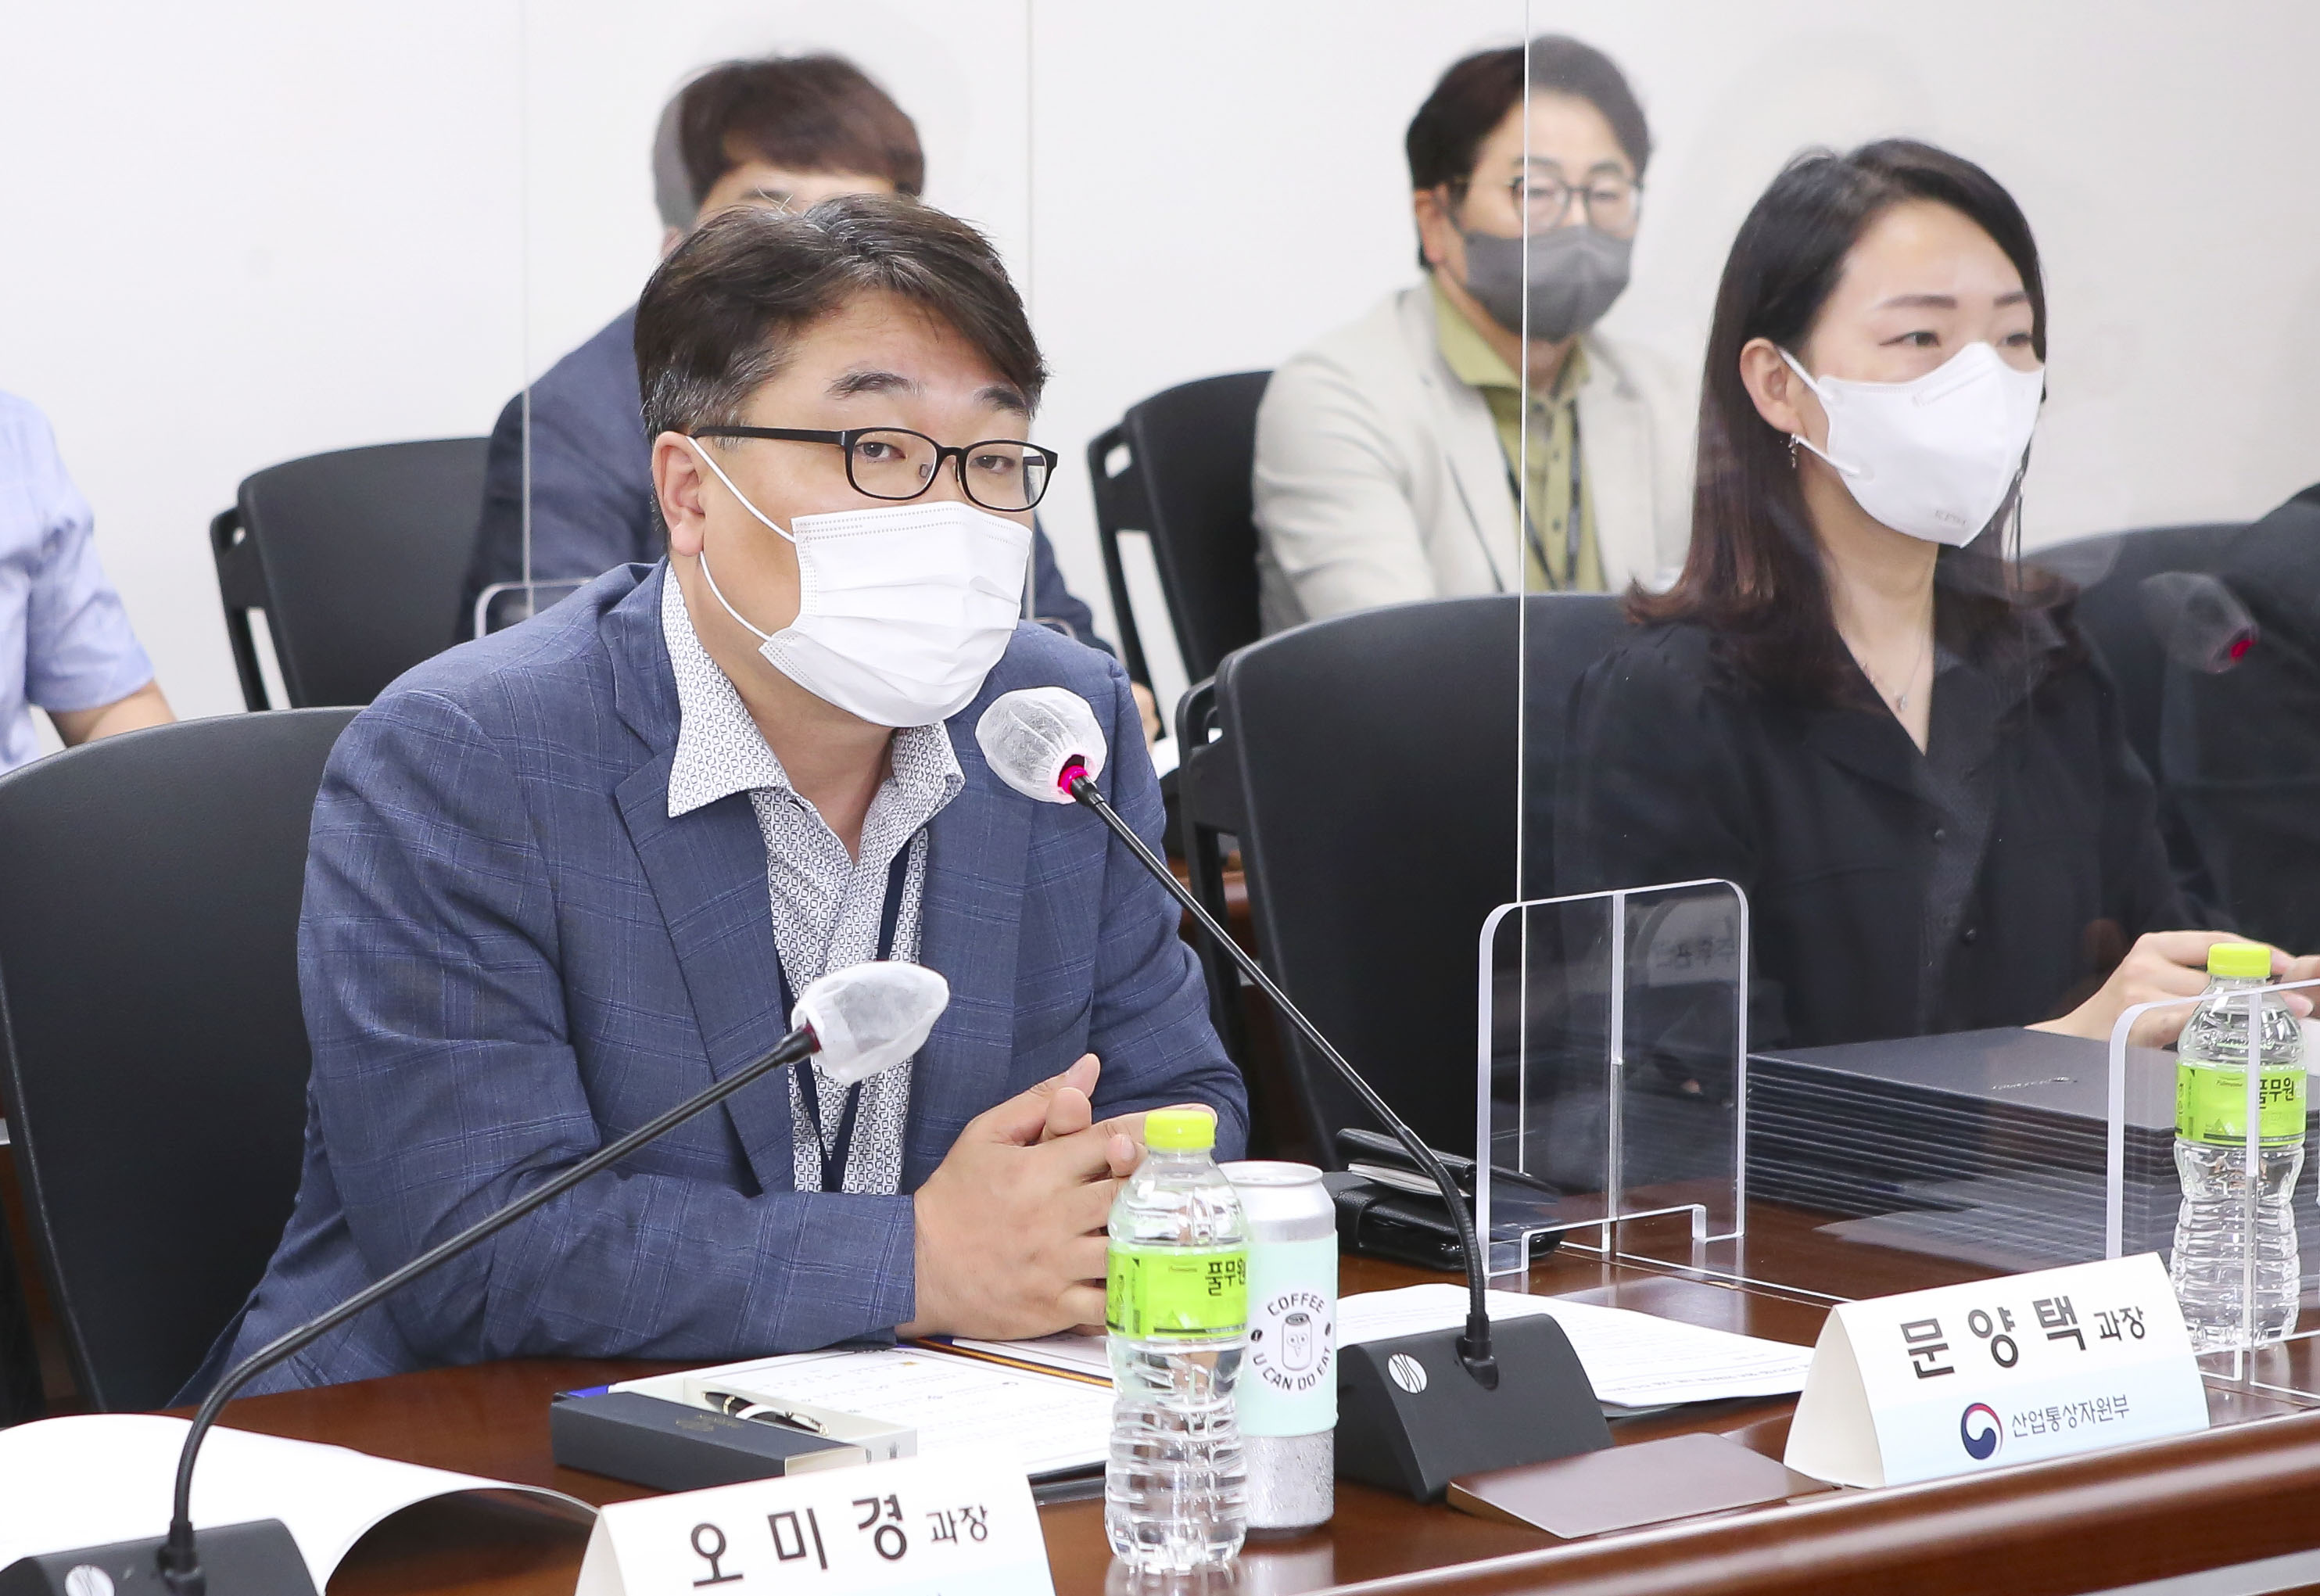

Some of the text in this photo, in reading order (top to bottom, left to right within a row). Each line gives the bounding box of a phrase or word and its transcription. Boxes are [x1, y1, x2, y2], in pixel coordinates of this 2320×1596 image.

[1267, 1292, 1325, 1317] COFFEE
[2093, 1306, 2146, 1342] 과장
[1253, 1346, 1332, 1391] U CAN DO EAT
[2012, 1394, 2130, 1438] 산업통상자원부
[927, 1505, 988, 1545] 과장
